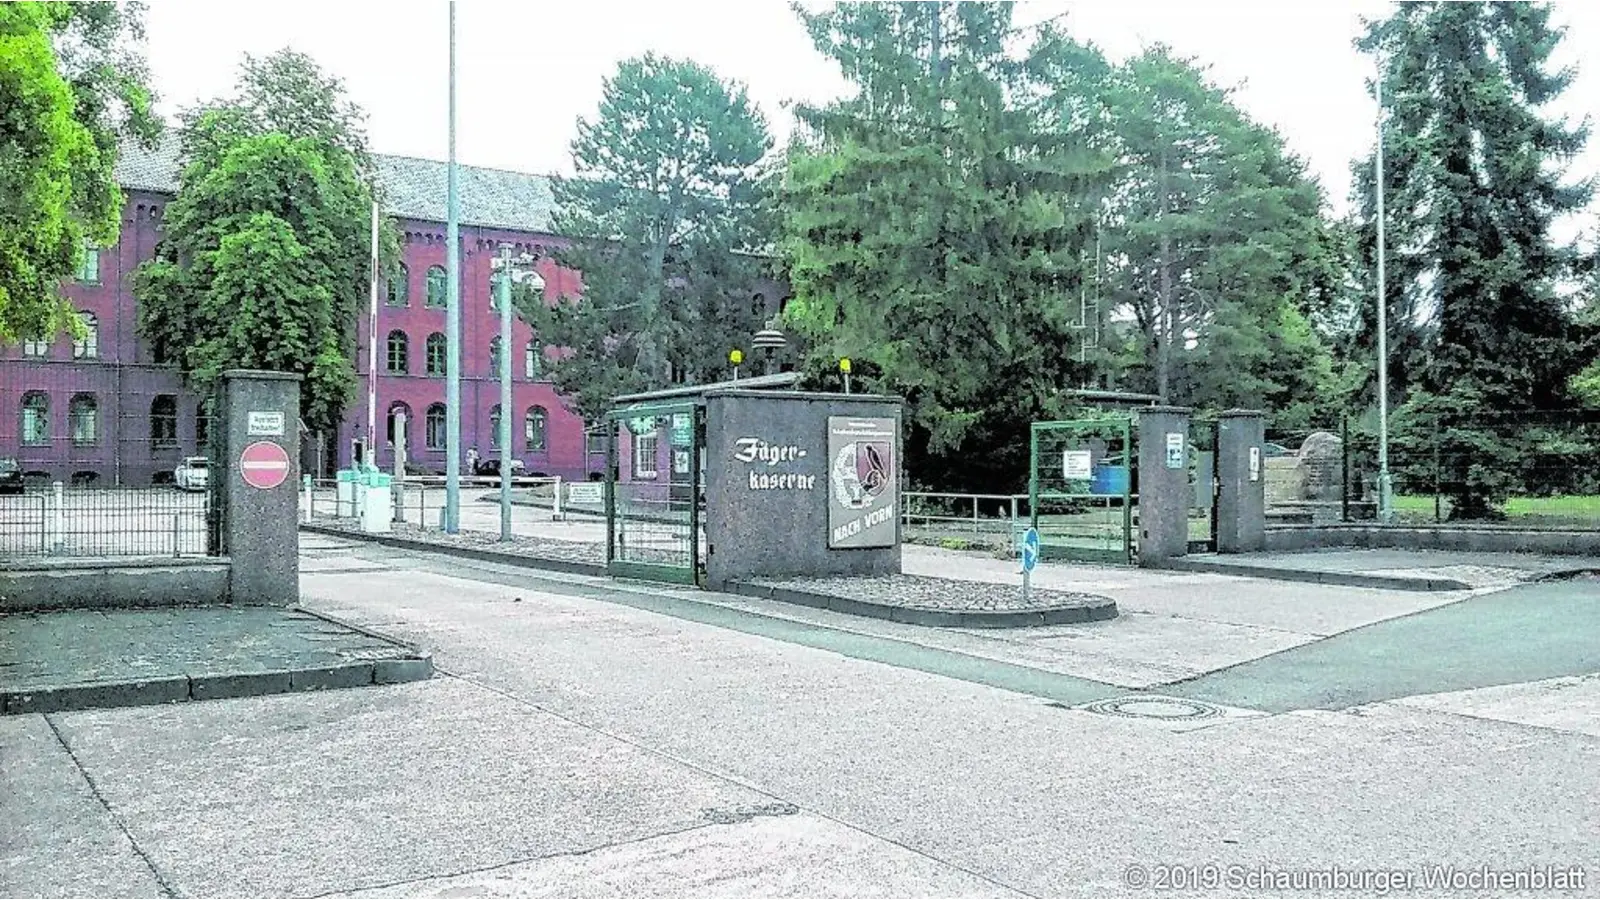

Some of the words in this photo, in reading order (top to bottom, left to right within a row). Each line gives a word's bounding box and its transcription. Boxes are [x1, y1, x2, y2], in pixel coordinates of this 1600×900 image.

[734, 437, 807, 466] Jäger-
[749, 470, 816, 489] kaserne
[834, 518, 861, 543] NACH
[864, 504, 893, 528] VORN
